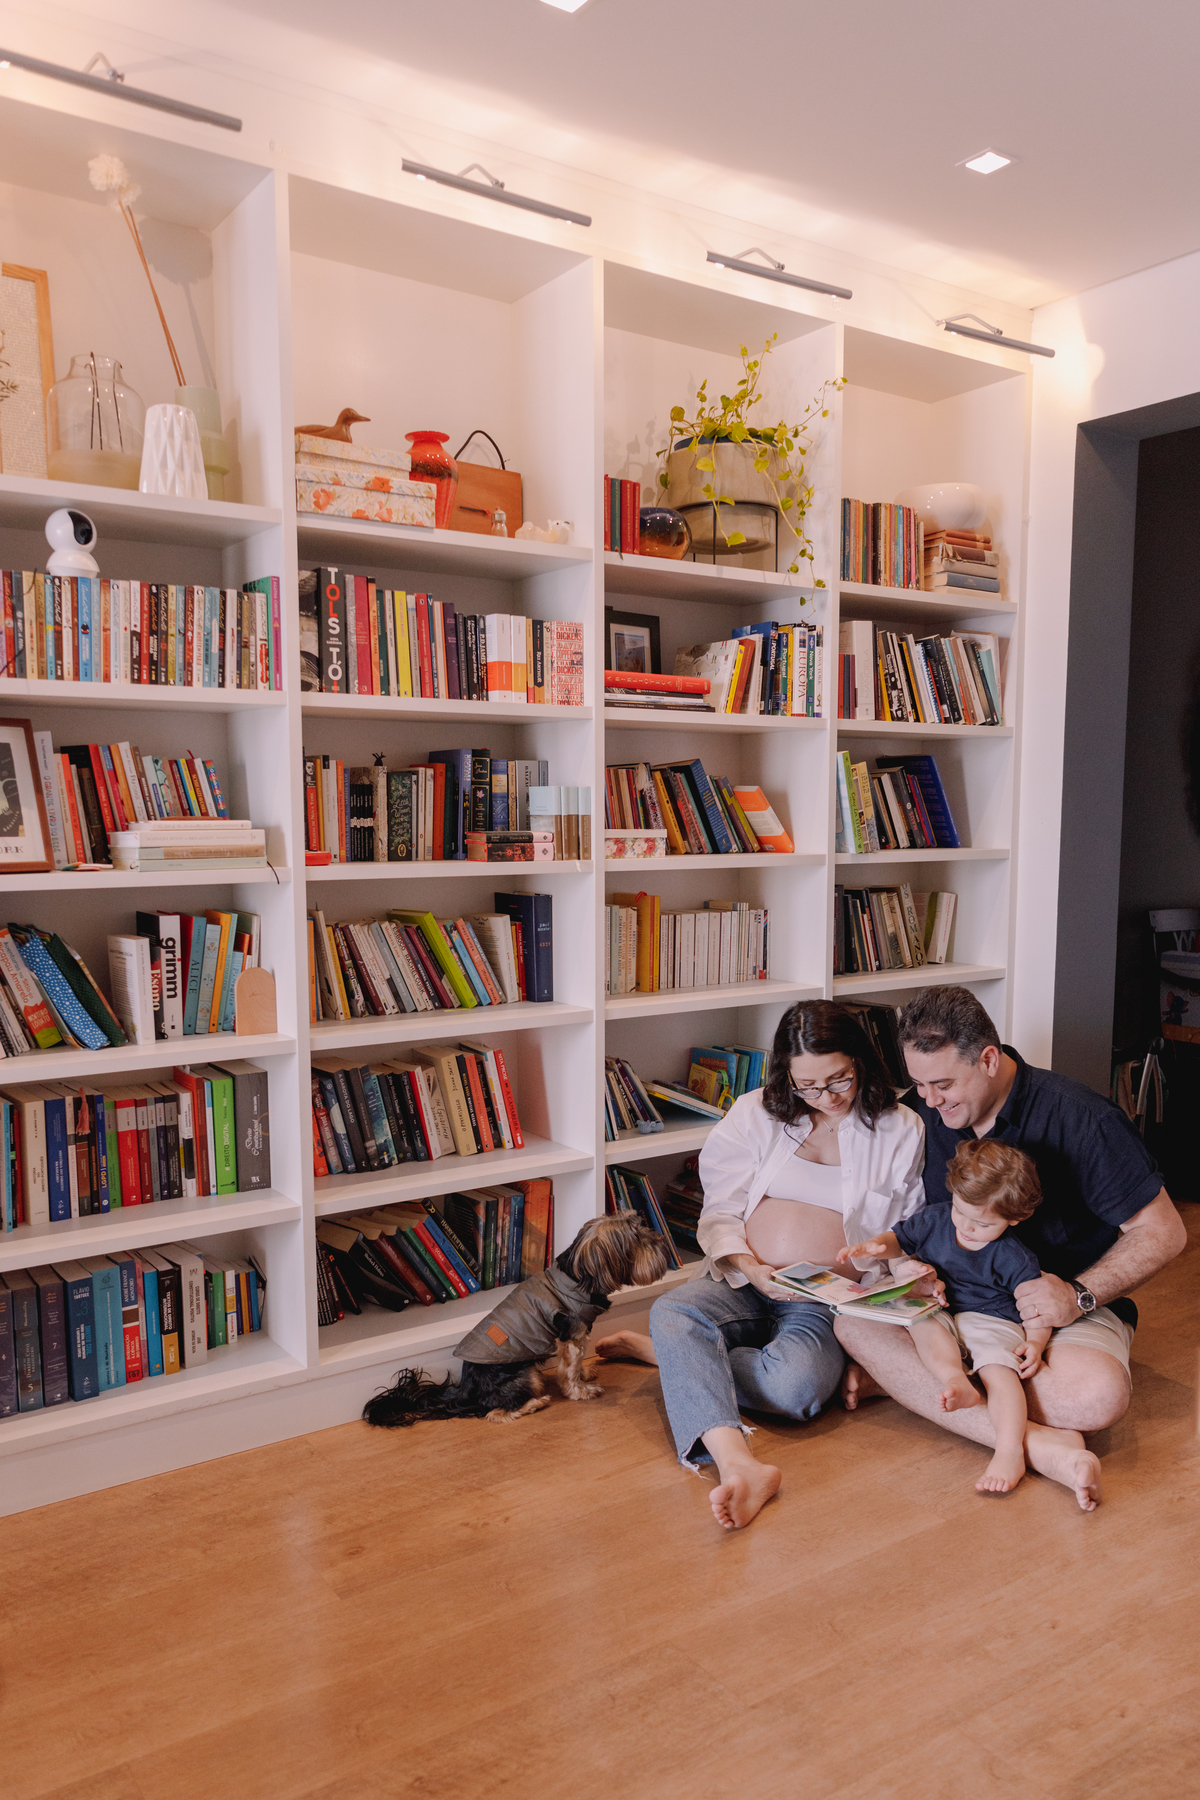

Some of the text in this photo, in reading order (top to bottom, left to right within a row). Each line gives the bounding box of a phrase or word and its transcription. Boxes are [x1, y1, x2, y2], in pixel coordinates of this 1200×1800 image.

[556, 631, 583, 642] DICKENS
[556, 666, 583, 676] DICKENS
[798, 651, 807, 699] EUROPA
[44, 781, 54, 806] GRANDE
[49, 808, 57, 826] LIVRO
[909, 811, 917, 830] MAUS
[384, 926, 401, 958] Modern Love
[4, 941, 31, 992] Aventuras Sítio
[159, 936, 182, 998] grimm
[188, 959, 201, 995] ALICE
[404, 953, 426, 994] RACHEL CUSK
[417, 964, 426, 981] NORMAL
[425, 981, 434, 997] PEOPLE
[10, 972, 29, 1004] Amarelo
[151, 968, 161, 1011] Esopo
[27, 1009, 49, 1022] MONTEIRO
[31, 1013, 51, 1029] LOBATO
[339, 1078, 348, 1100] GAROTA
[500, 1064, 508, 1080] PROSE
[508, 1096, 519, 1131] CAMAREIRA
[245, 1127, 253, 1150] Direito
[251, 1119, 260, 1156] Constitucional
[439, 1219, 453, 1235] HARRY
[451, 1234, 466, 1251] POTTER
[363, 1252, 385, 1278] Sherlock Holmes
[73, 1286, 90, 1295] FLÁVIO
[52, 1342, 58, 1350] 7
[27, 1383, 34, 1393] 5
